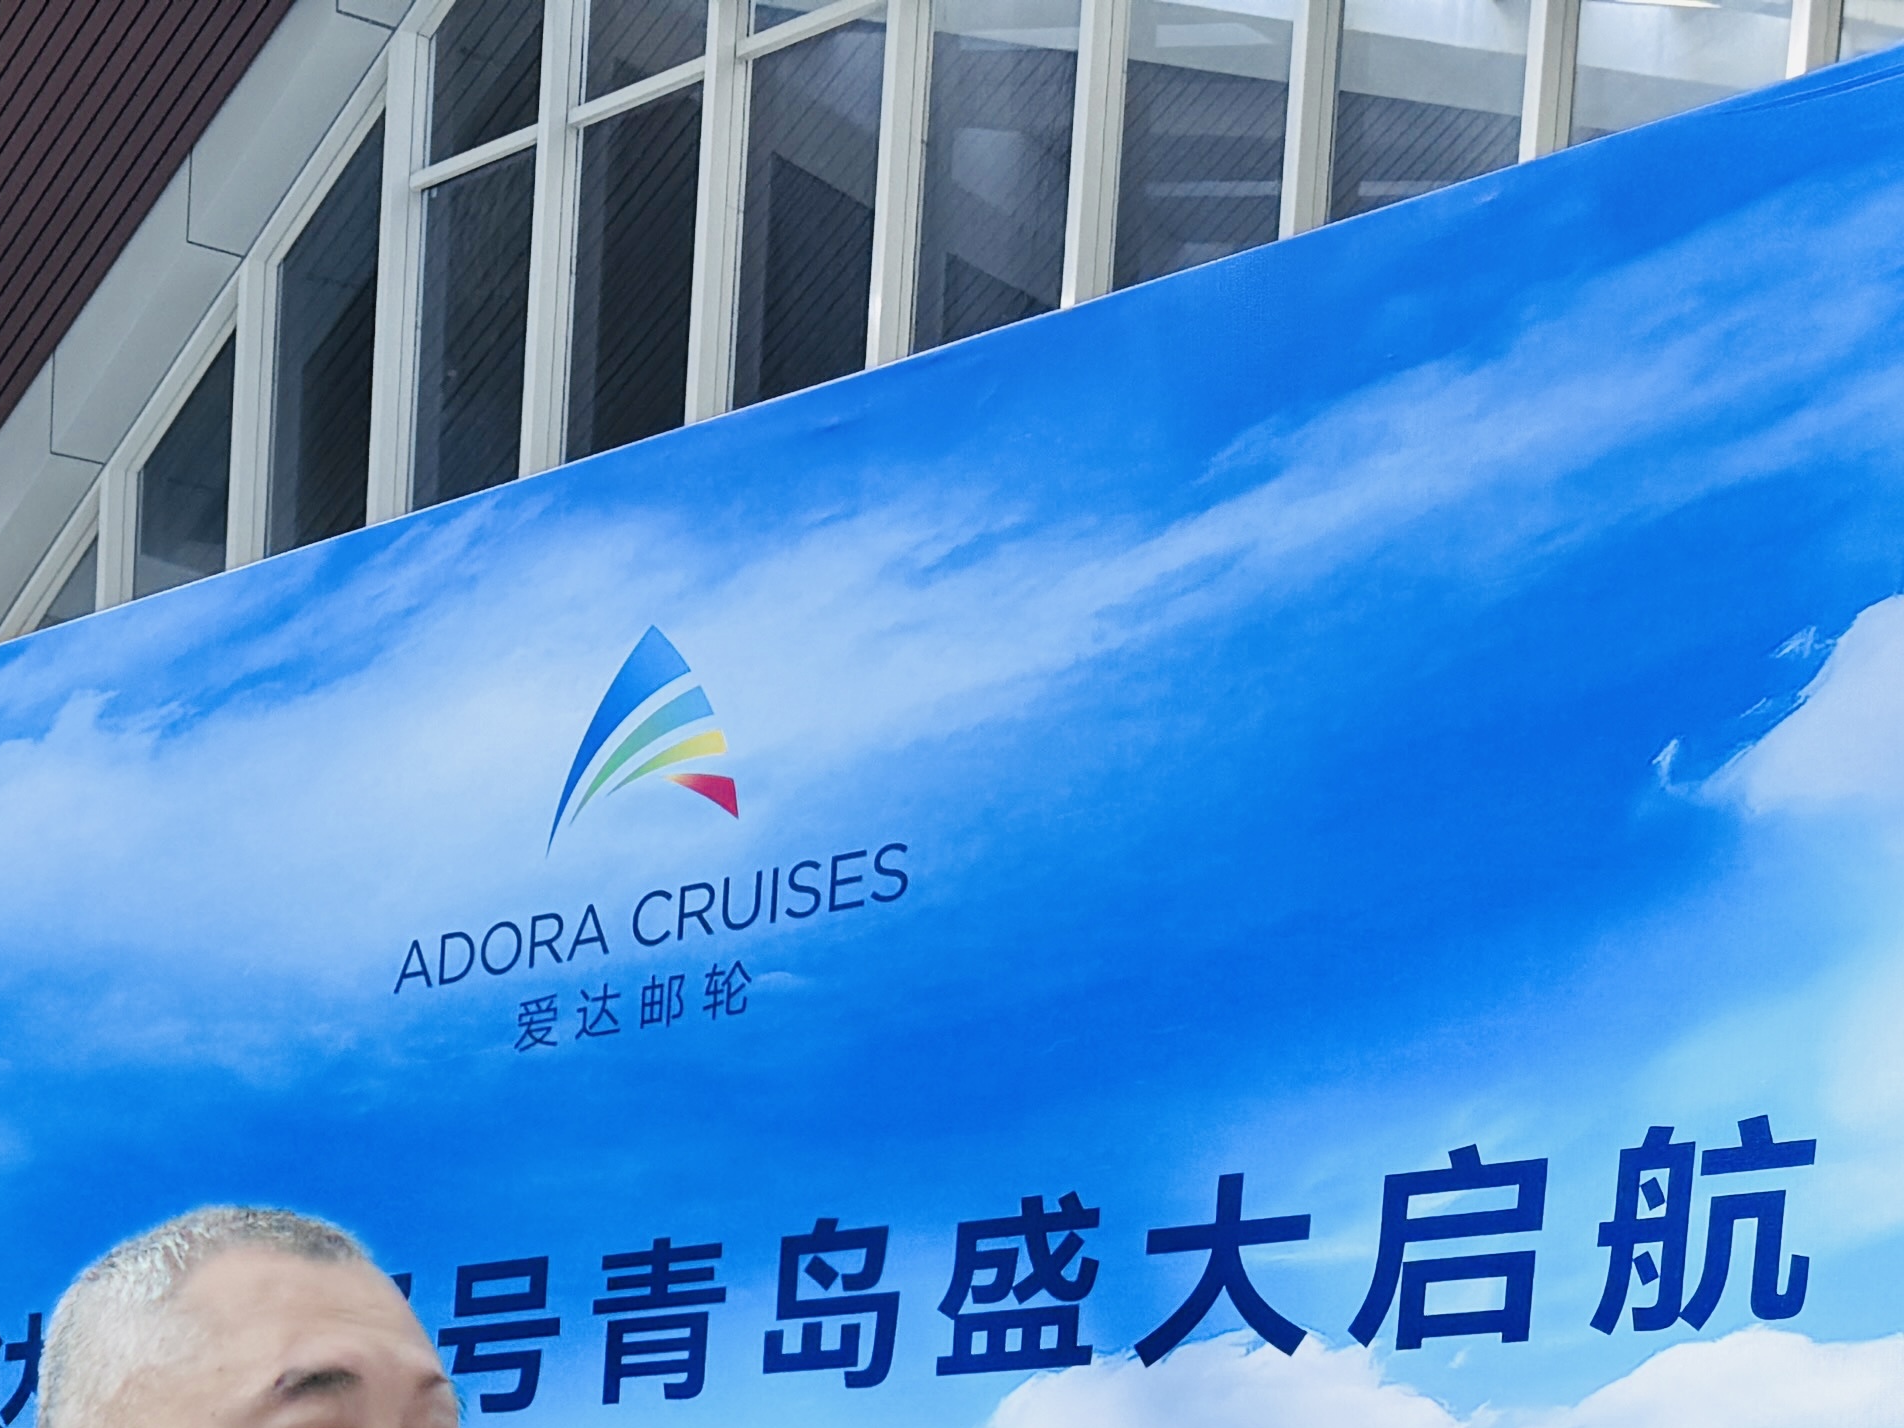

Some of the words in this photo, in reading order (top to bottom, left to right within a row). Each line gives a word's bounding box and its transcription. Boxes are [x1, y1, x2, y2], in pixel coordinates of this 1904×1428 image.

[393, 903, 610, 994] ADORA
[632, 842, 910, 947] CRUISES
[513, 960, 754, 1053] 爱达邮轮
